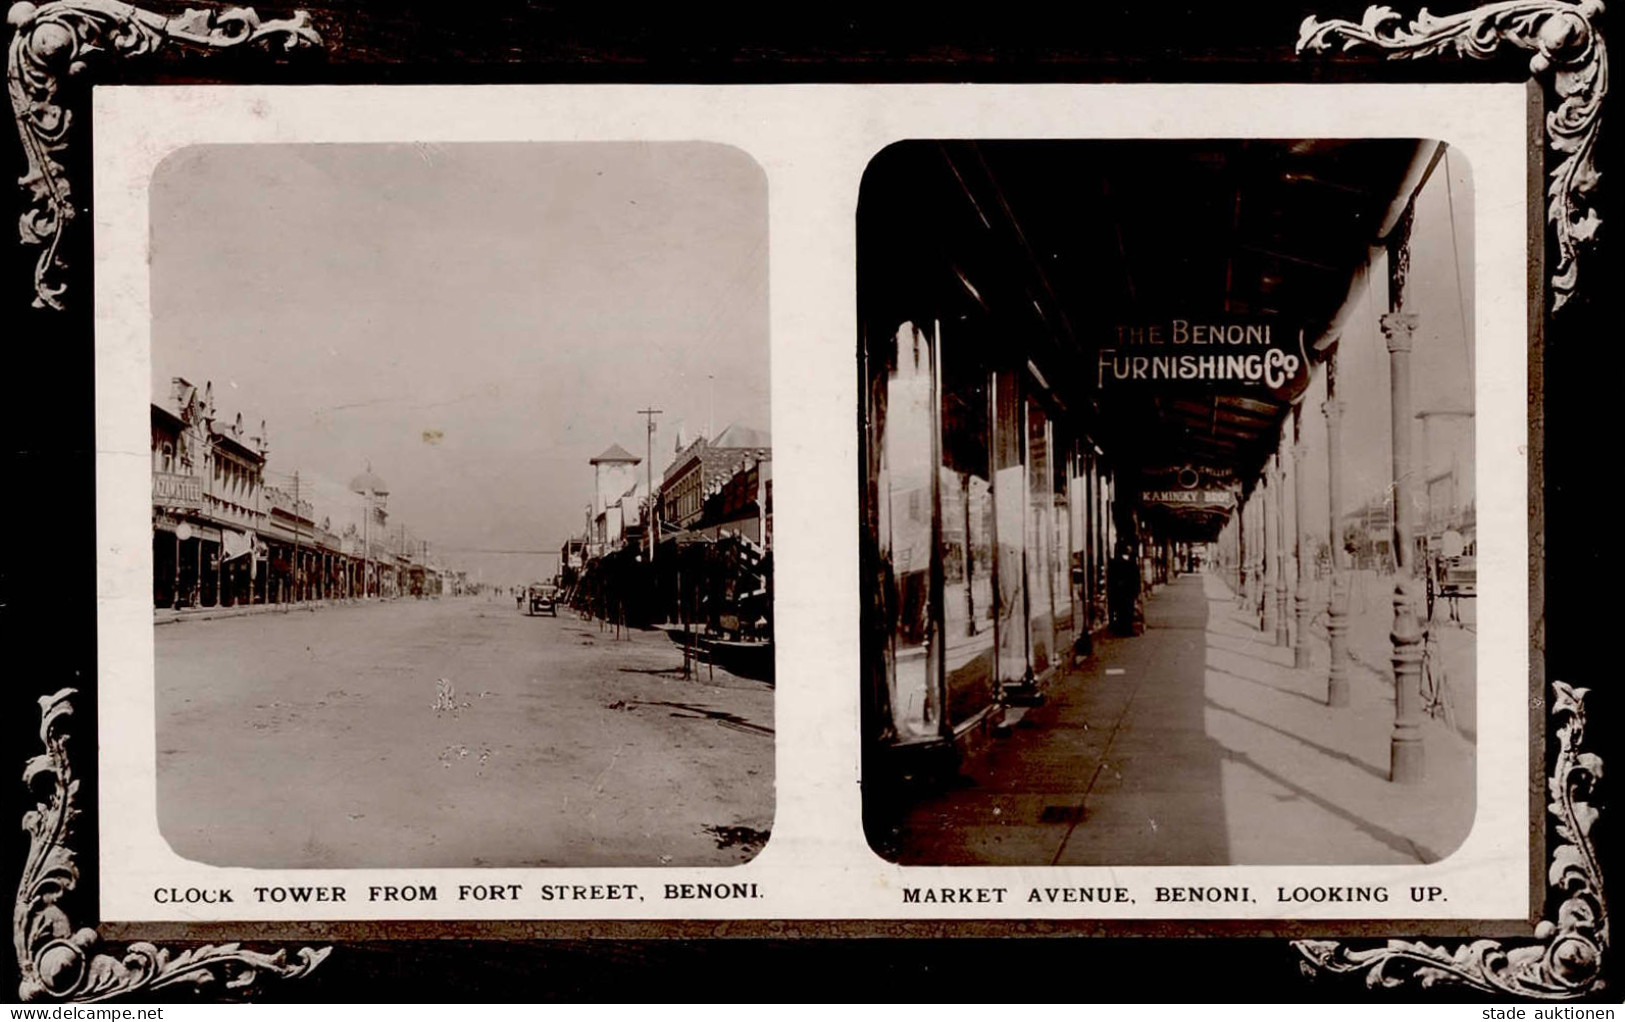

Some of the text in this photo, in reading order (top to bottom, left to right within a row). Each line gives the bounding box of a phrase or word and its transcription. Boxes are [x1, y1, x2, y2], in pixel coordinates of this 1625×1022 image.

[1115, 319, 1271, 345] THE BENONI
[1098, 349, 1263, 388] FURNISHING
[153, 883, 764, 904] CLOCK TOWER FROM FORT STREET, BENONI.
[902, 887, 1008, 904] MARKET
[1027, 887, 1136, 905] AVENUE,
[1277, 886, 1389, 903] LOOKING
[1410, 886, 1448, 903] UP.
